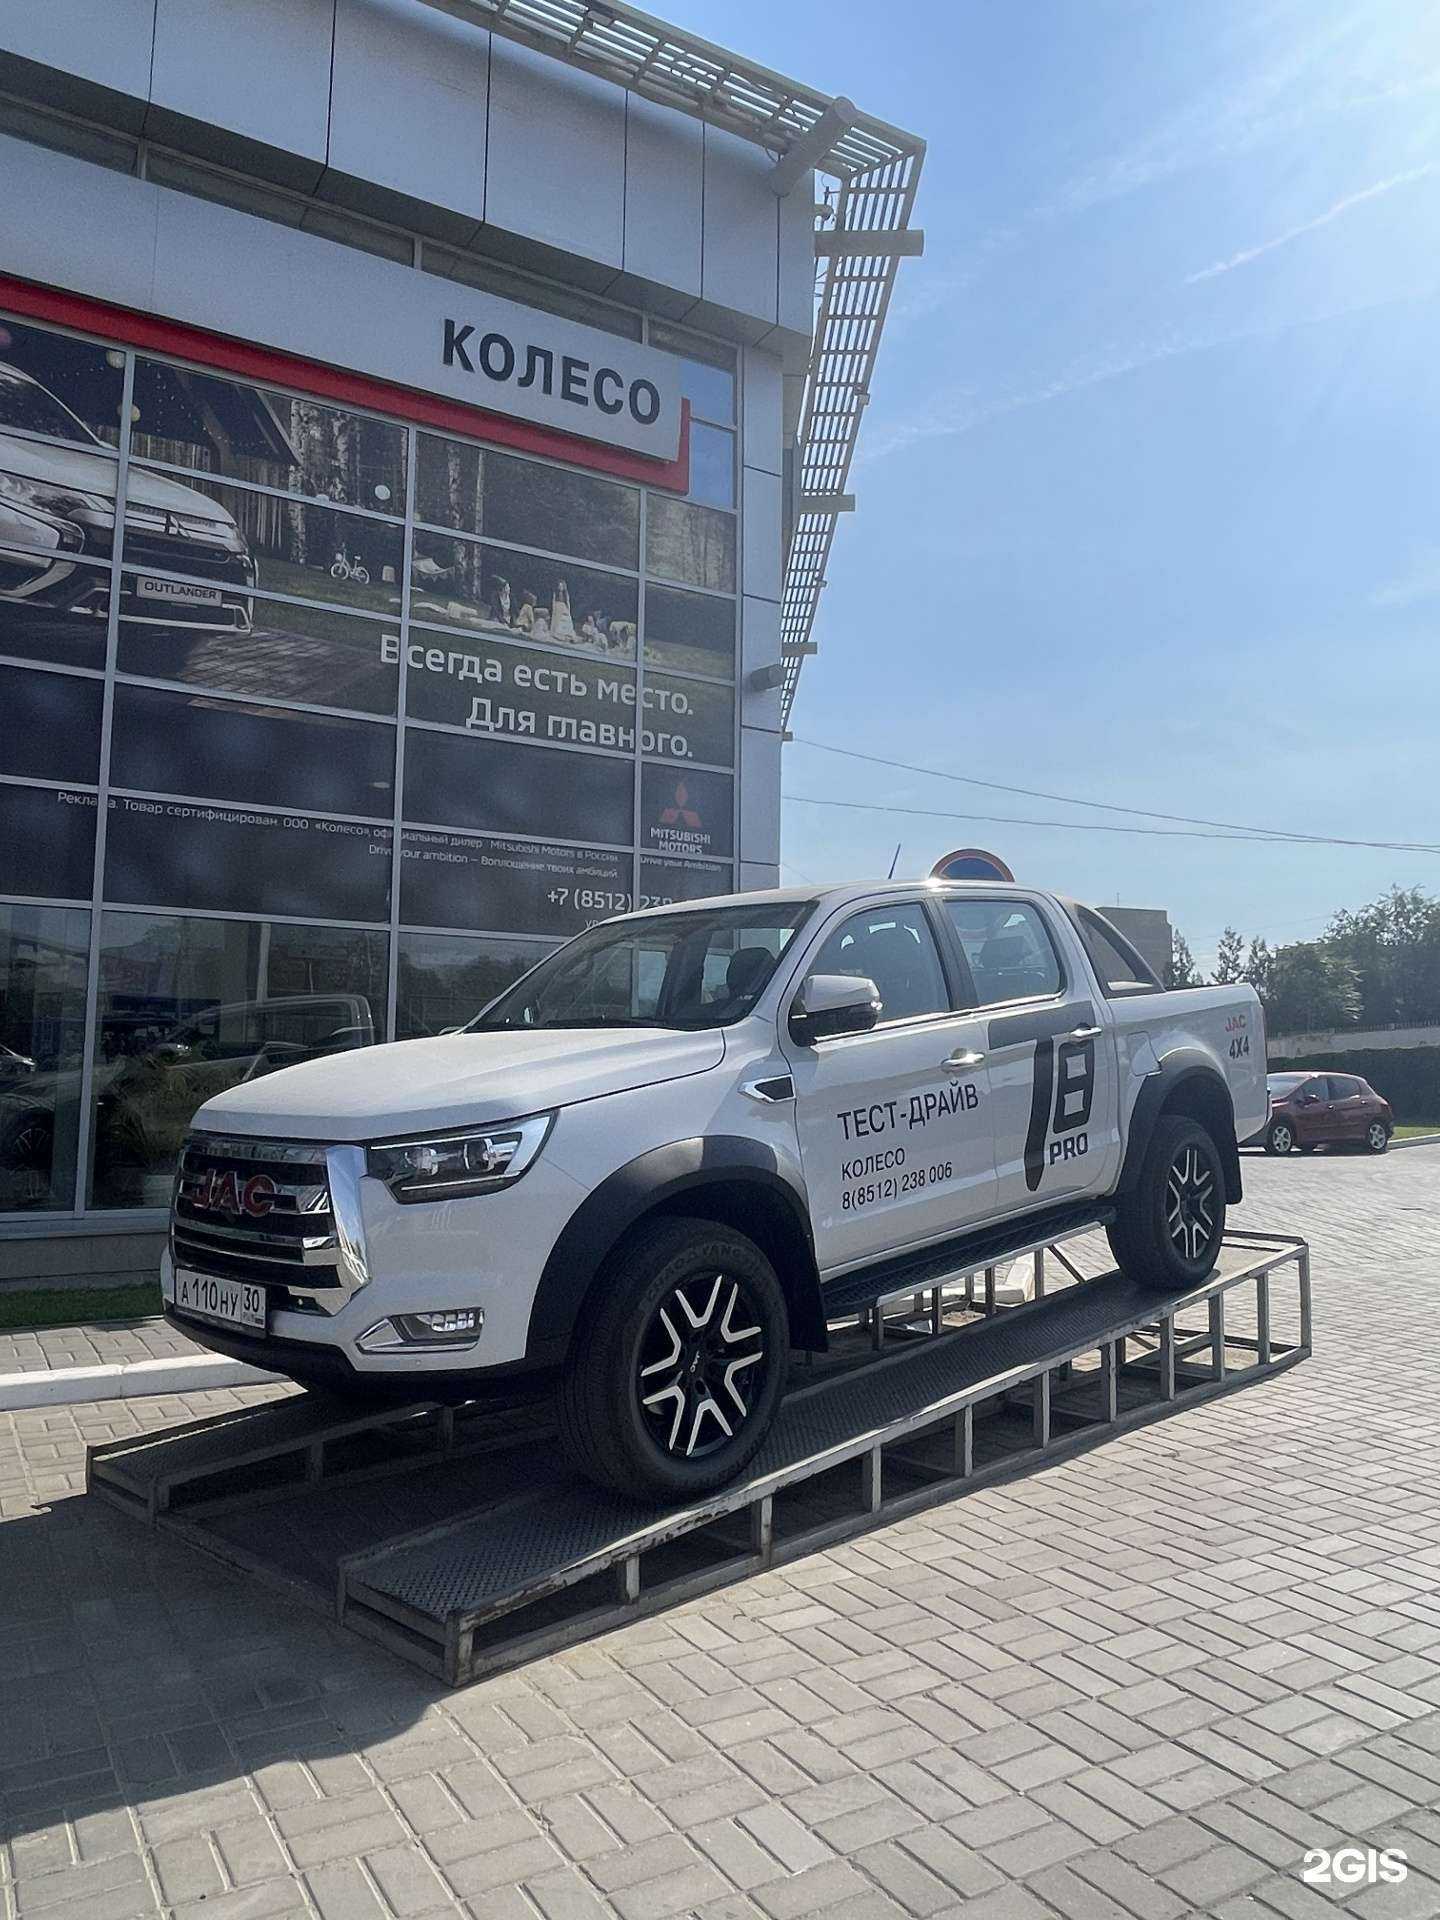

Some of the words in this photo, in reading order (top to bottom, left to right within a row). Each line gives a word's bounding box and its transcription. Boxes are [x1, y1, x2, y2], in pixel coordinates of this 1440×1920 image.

[442, 318, 661, 425] КОЛЕСО
[144, 581, 217, 599] OUTLANDER
[380, 634, 502, 684] Всегда
[513, 663, 587, 697] есть
[597, 678, 693, 716] место.
[465, 697, 536, 733] Для
[547, 714, 693, 758] главного.
[57, 791, 119, 809] Реклаа.
[123, 798, 164, 815] Товар
[166, 804, 278, 826] сертифицирован
[650, 827, 711, 845] MITSUBISHI
[659, 840, 703, 854] MOTORS
[422, 851, 469, 864] ambition
[547, 887, 569, 906] +7
[574, 888, 632, 913] (8512)
[1225, 1014, 1247, 1033] JAC
[836, 1080, 979, 1140] ТЕСТ-ДРАЙВ
[841, 1147, 905, 1181] КОЛЕСО
[1049, 1132, 1089, 1166] PRO
[192, 1168, 278, 1218] JAC
[842, 1177, 898, 1211] 8(8512)
[901, 1169, 926, 1192] 238
[929, 1161, 953, 1184] 006
